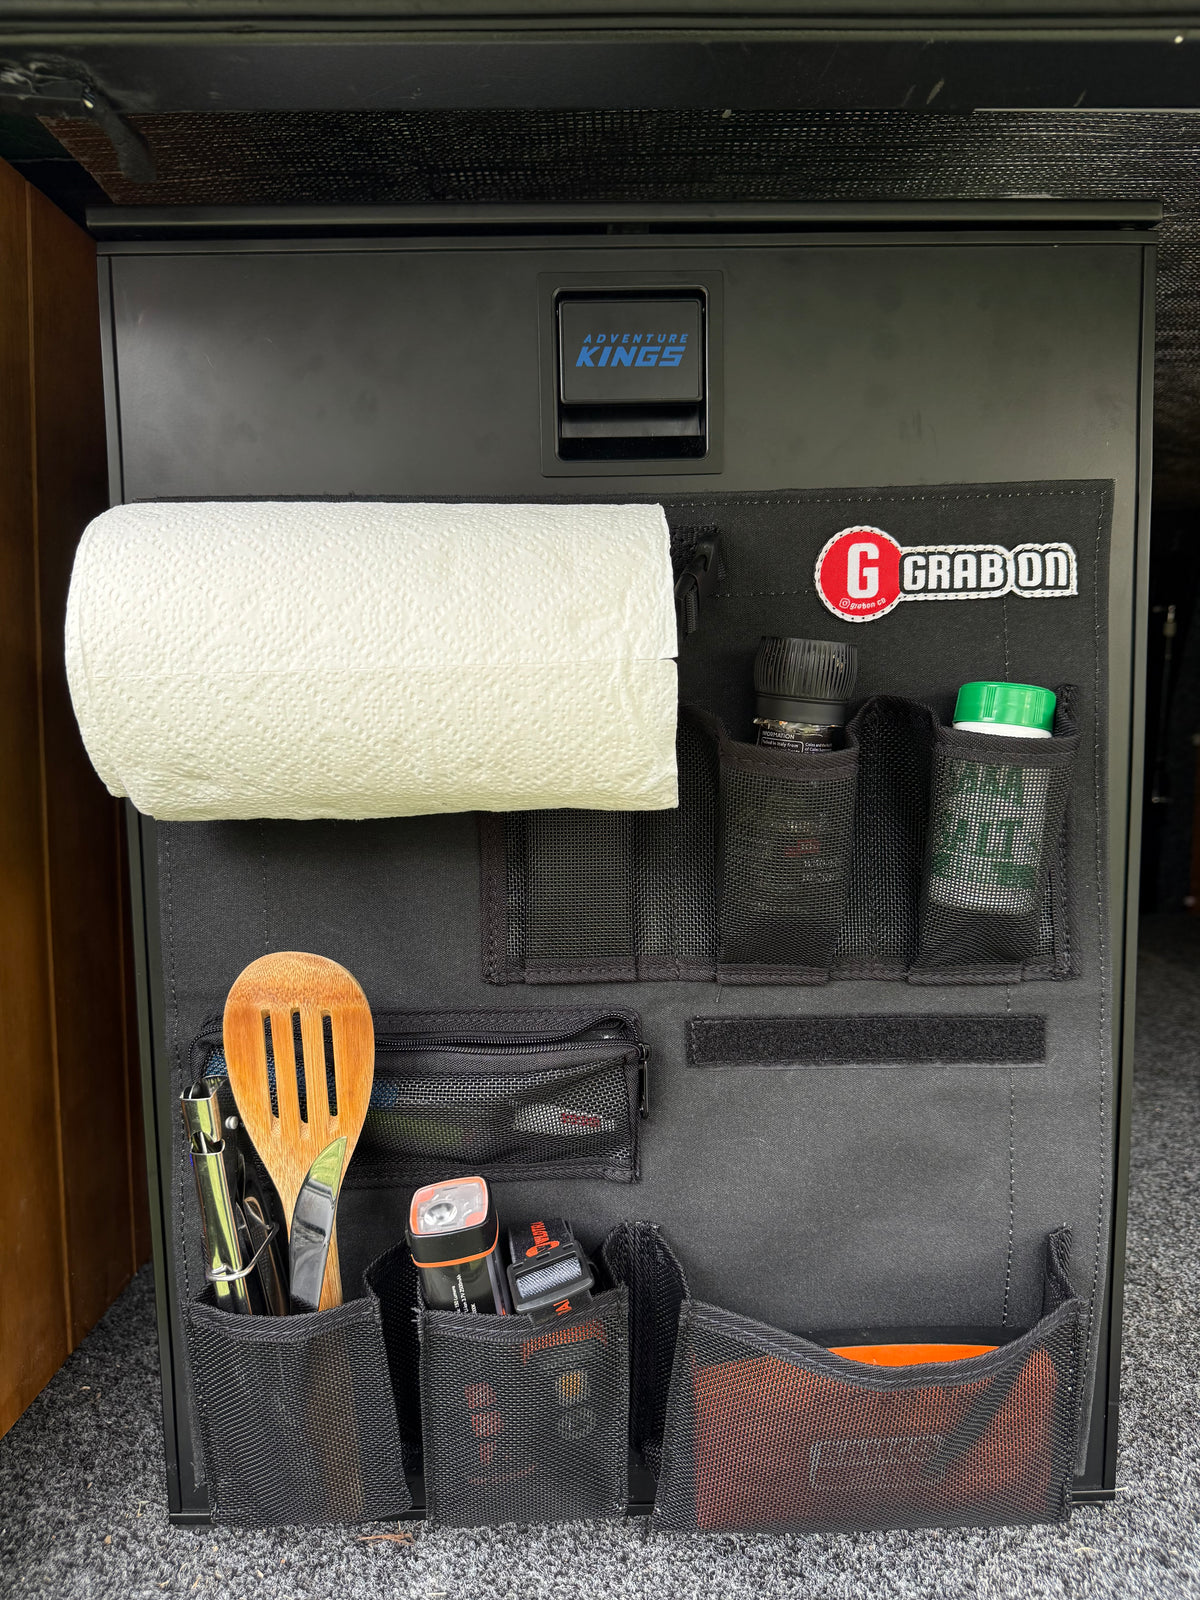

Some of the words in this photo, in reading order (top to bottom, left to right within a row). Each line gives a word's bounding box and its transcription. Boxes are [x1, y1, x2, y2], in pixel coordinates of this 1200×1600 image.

[583, 333, 689, 343] ADVENTURE
[575, 346, 686, 367] KINGS
[847, 543, 879, 599] G
[903, 553, 1005, 591] GRAB
